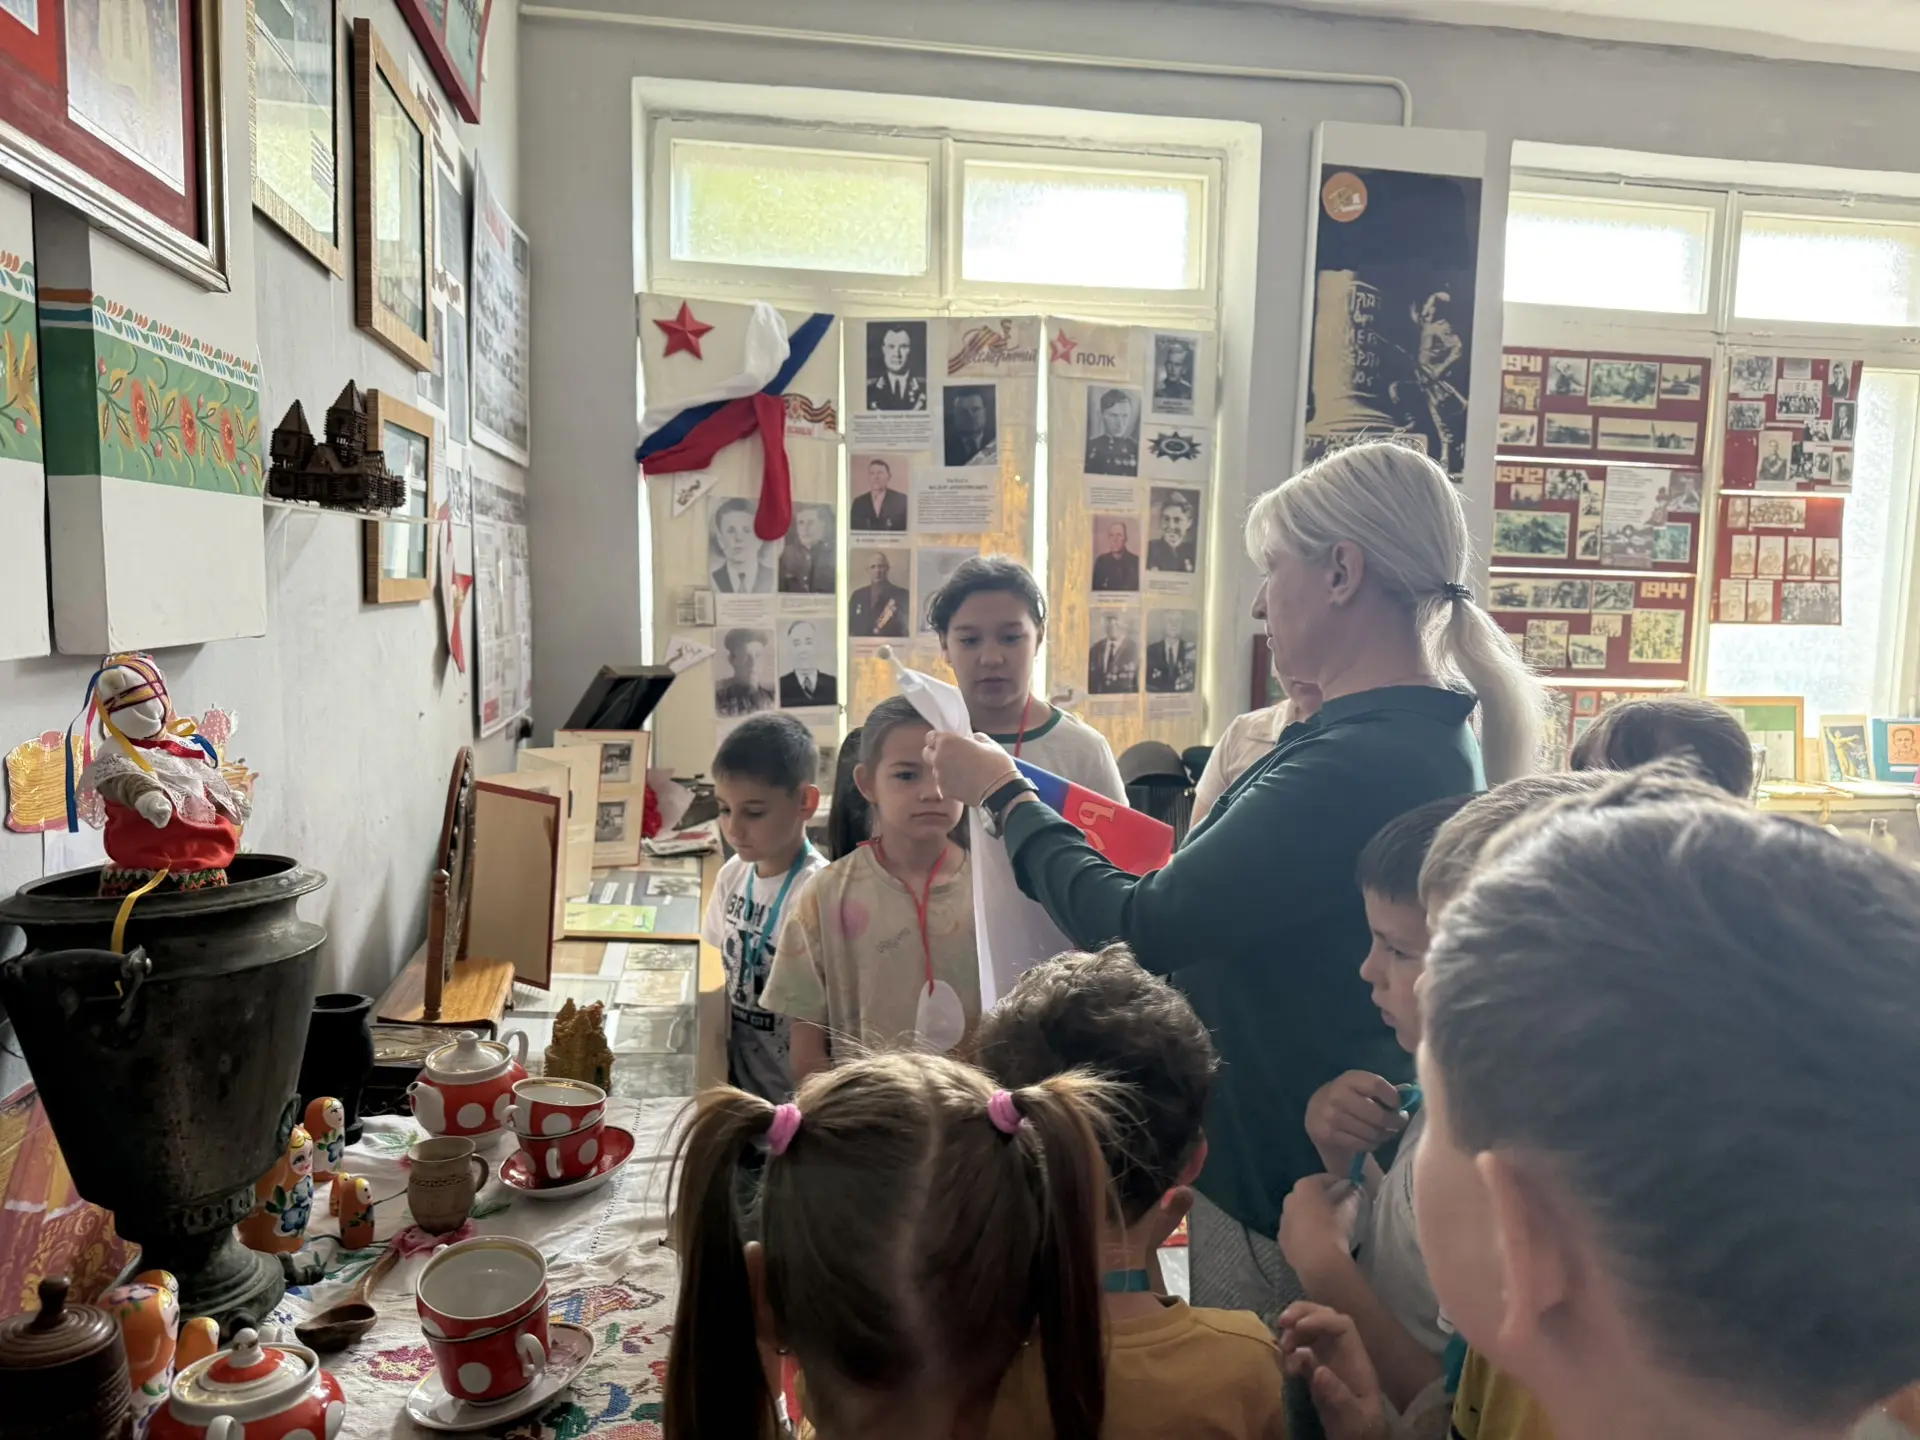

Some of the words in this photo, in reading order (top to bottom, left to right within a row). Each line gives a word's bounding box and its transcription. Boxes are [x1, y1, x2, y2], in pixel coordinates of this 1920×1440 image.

[1501, 354, 1543, 372] 1941
[1496, 466, 1544, 483] 1942
[1640, 581, 1687, 599] 1944
